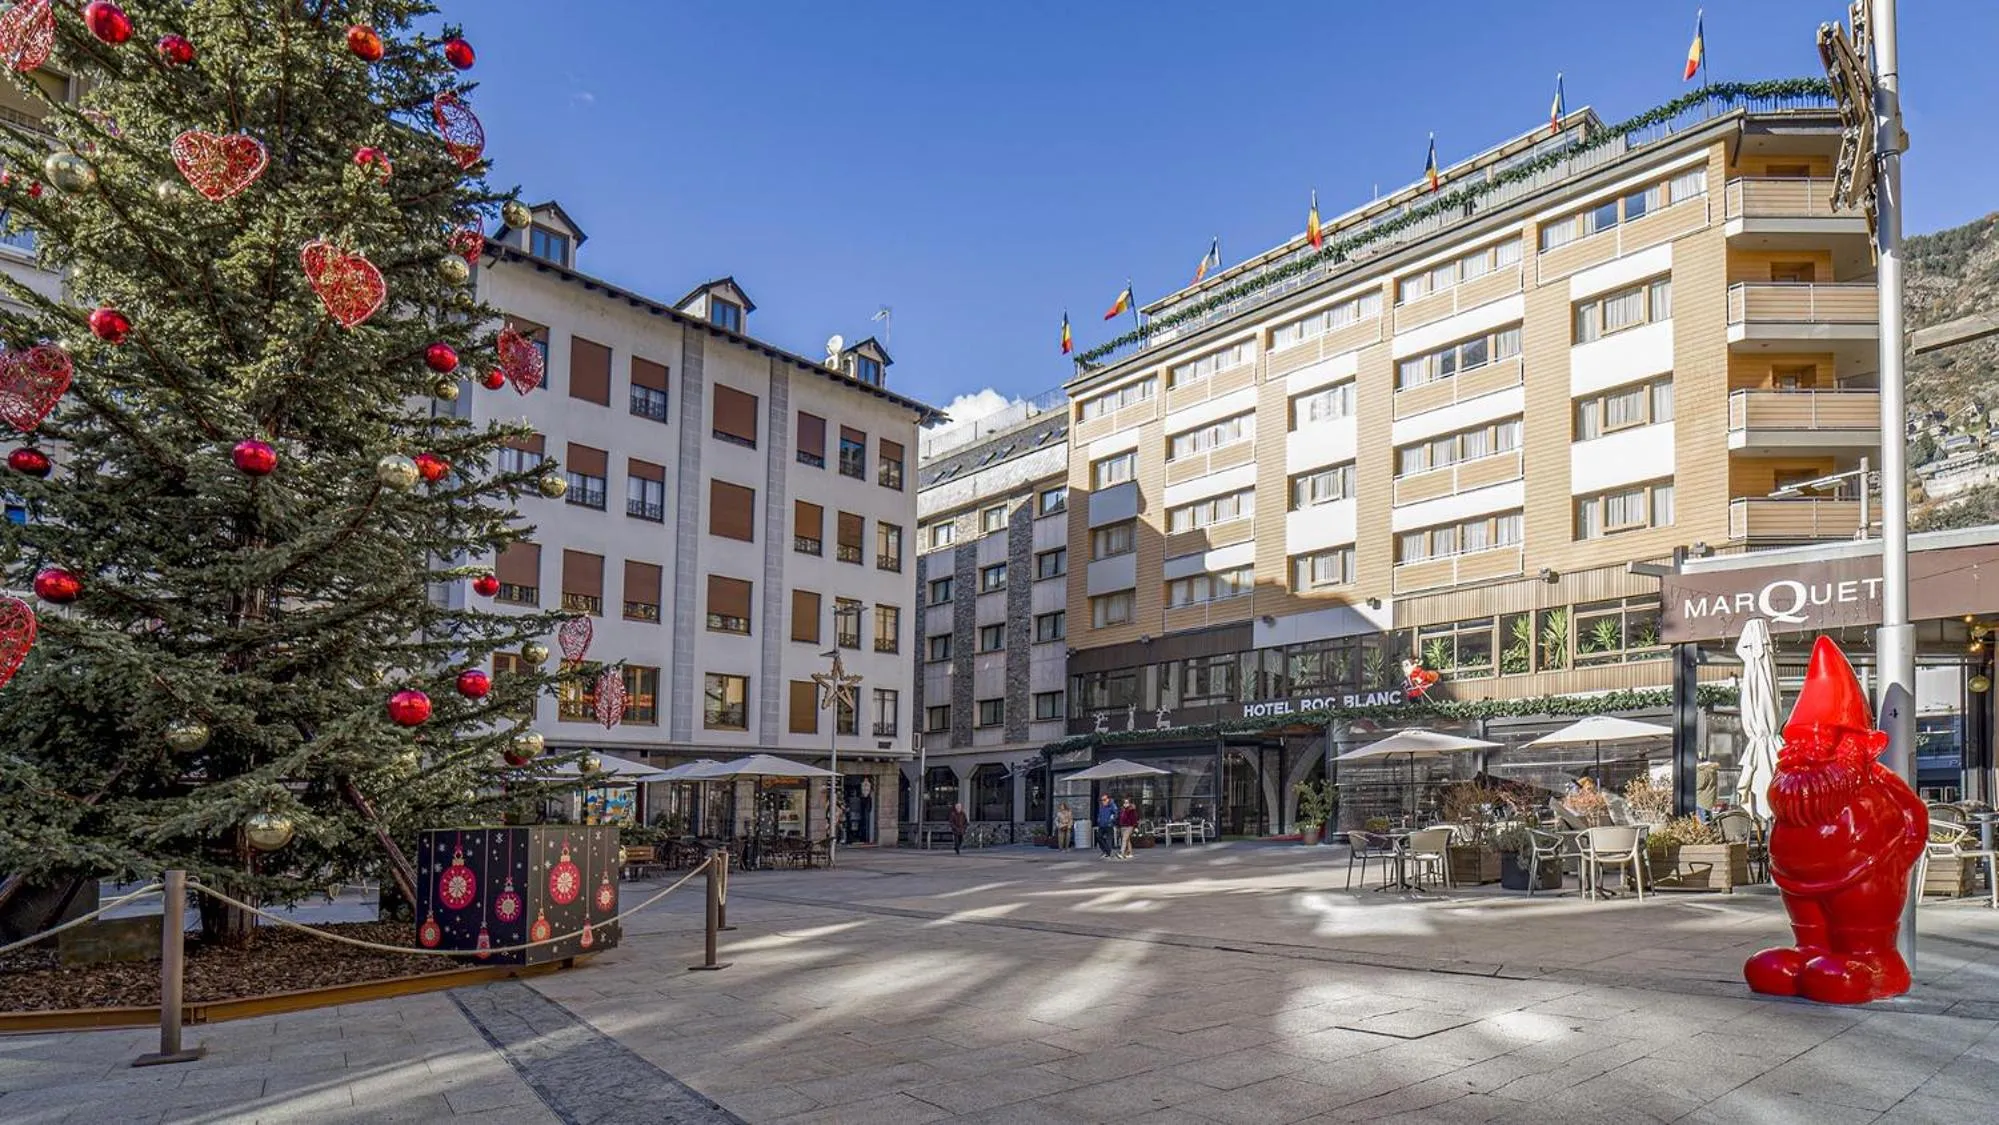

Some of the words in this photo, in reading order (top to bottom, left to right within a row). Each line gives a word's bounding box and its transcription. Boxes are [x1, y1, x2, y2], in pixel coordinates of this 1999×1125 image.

[1684, 577, 1883, 623] MARQUET
[1243, 701, 1294, 718] HOTEL
[1300, 697, 1336, 713] ROC
[1343, 690, 1402, 709] BLANC
